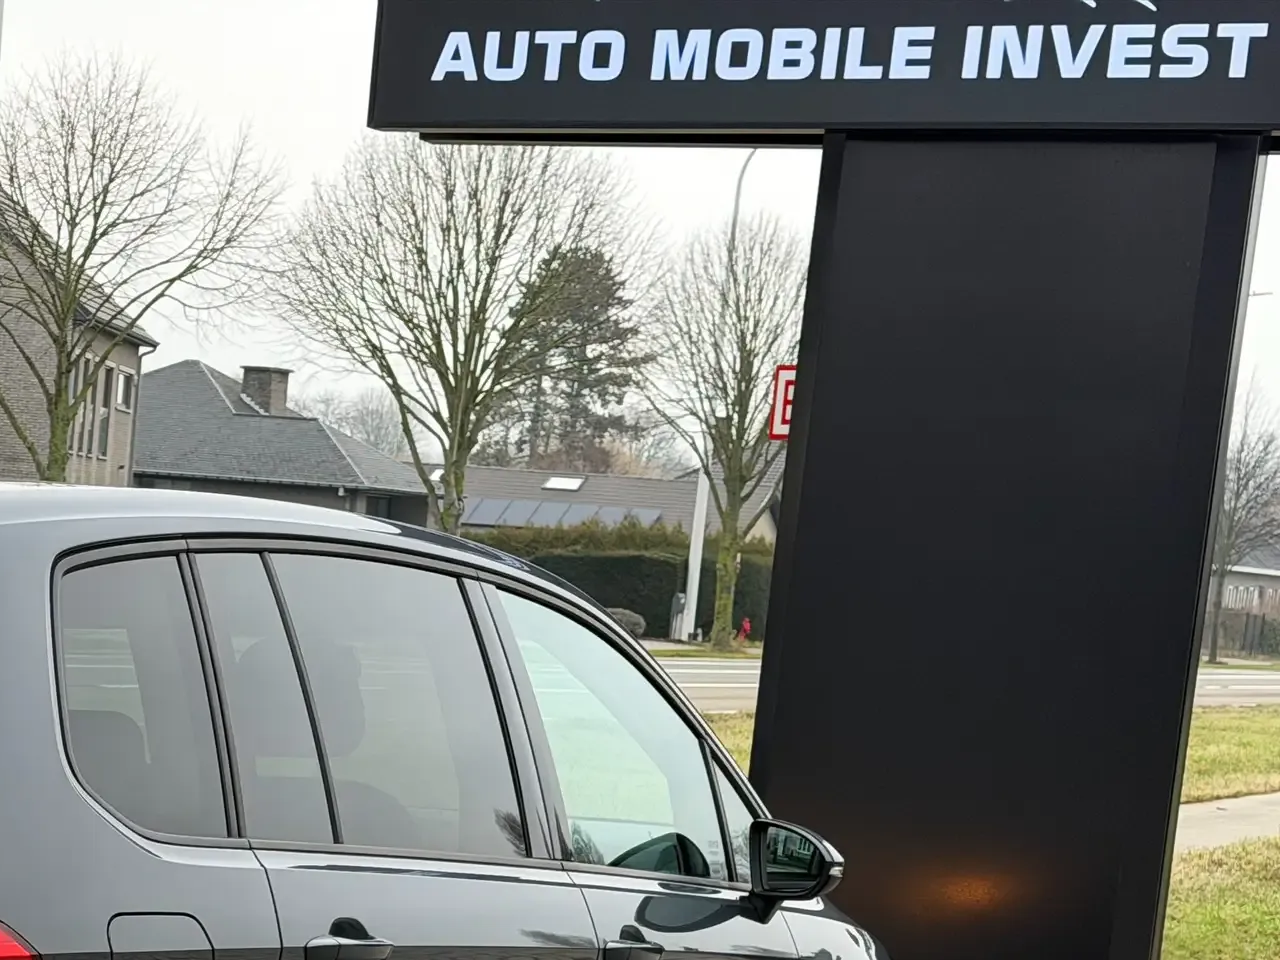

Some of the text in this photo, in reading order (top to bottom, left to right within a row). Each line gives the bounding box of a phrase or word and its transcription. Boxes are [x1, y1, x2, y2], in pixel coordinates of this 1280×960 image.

[431, 23, 1268, 81] AUTO MOBILE INVEST
